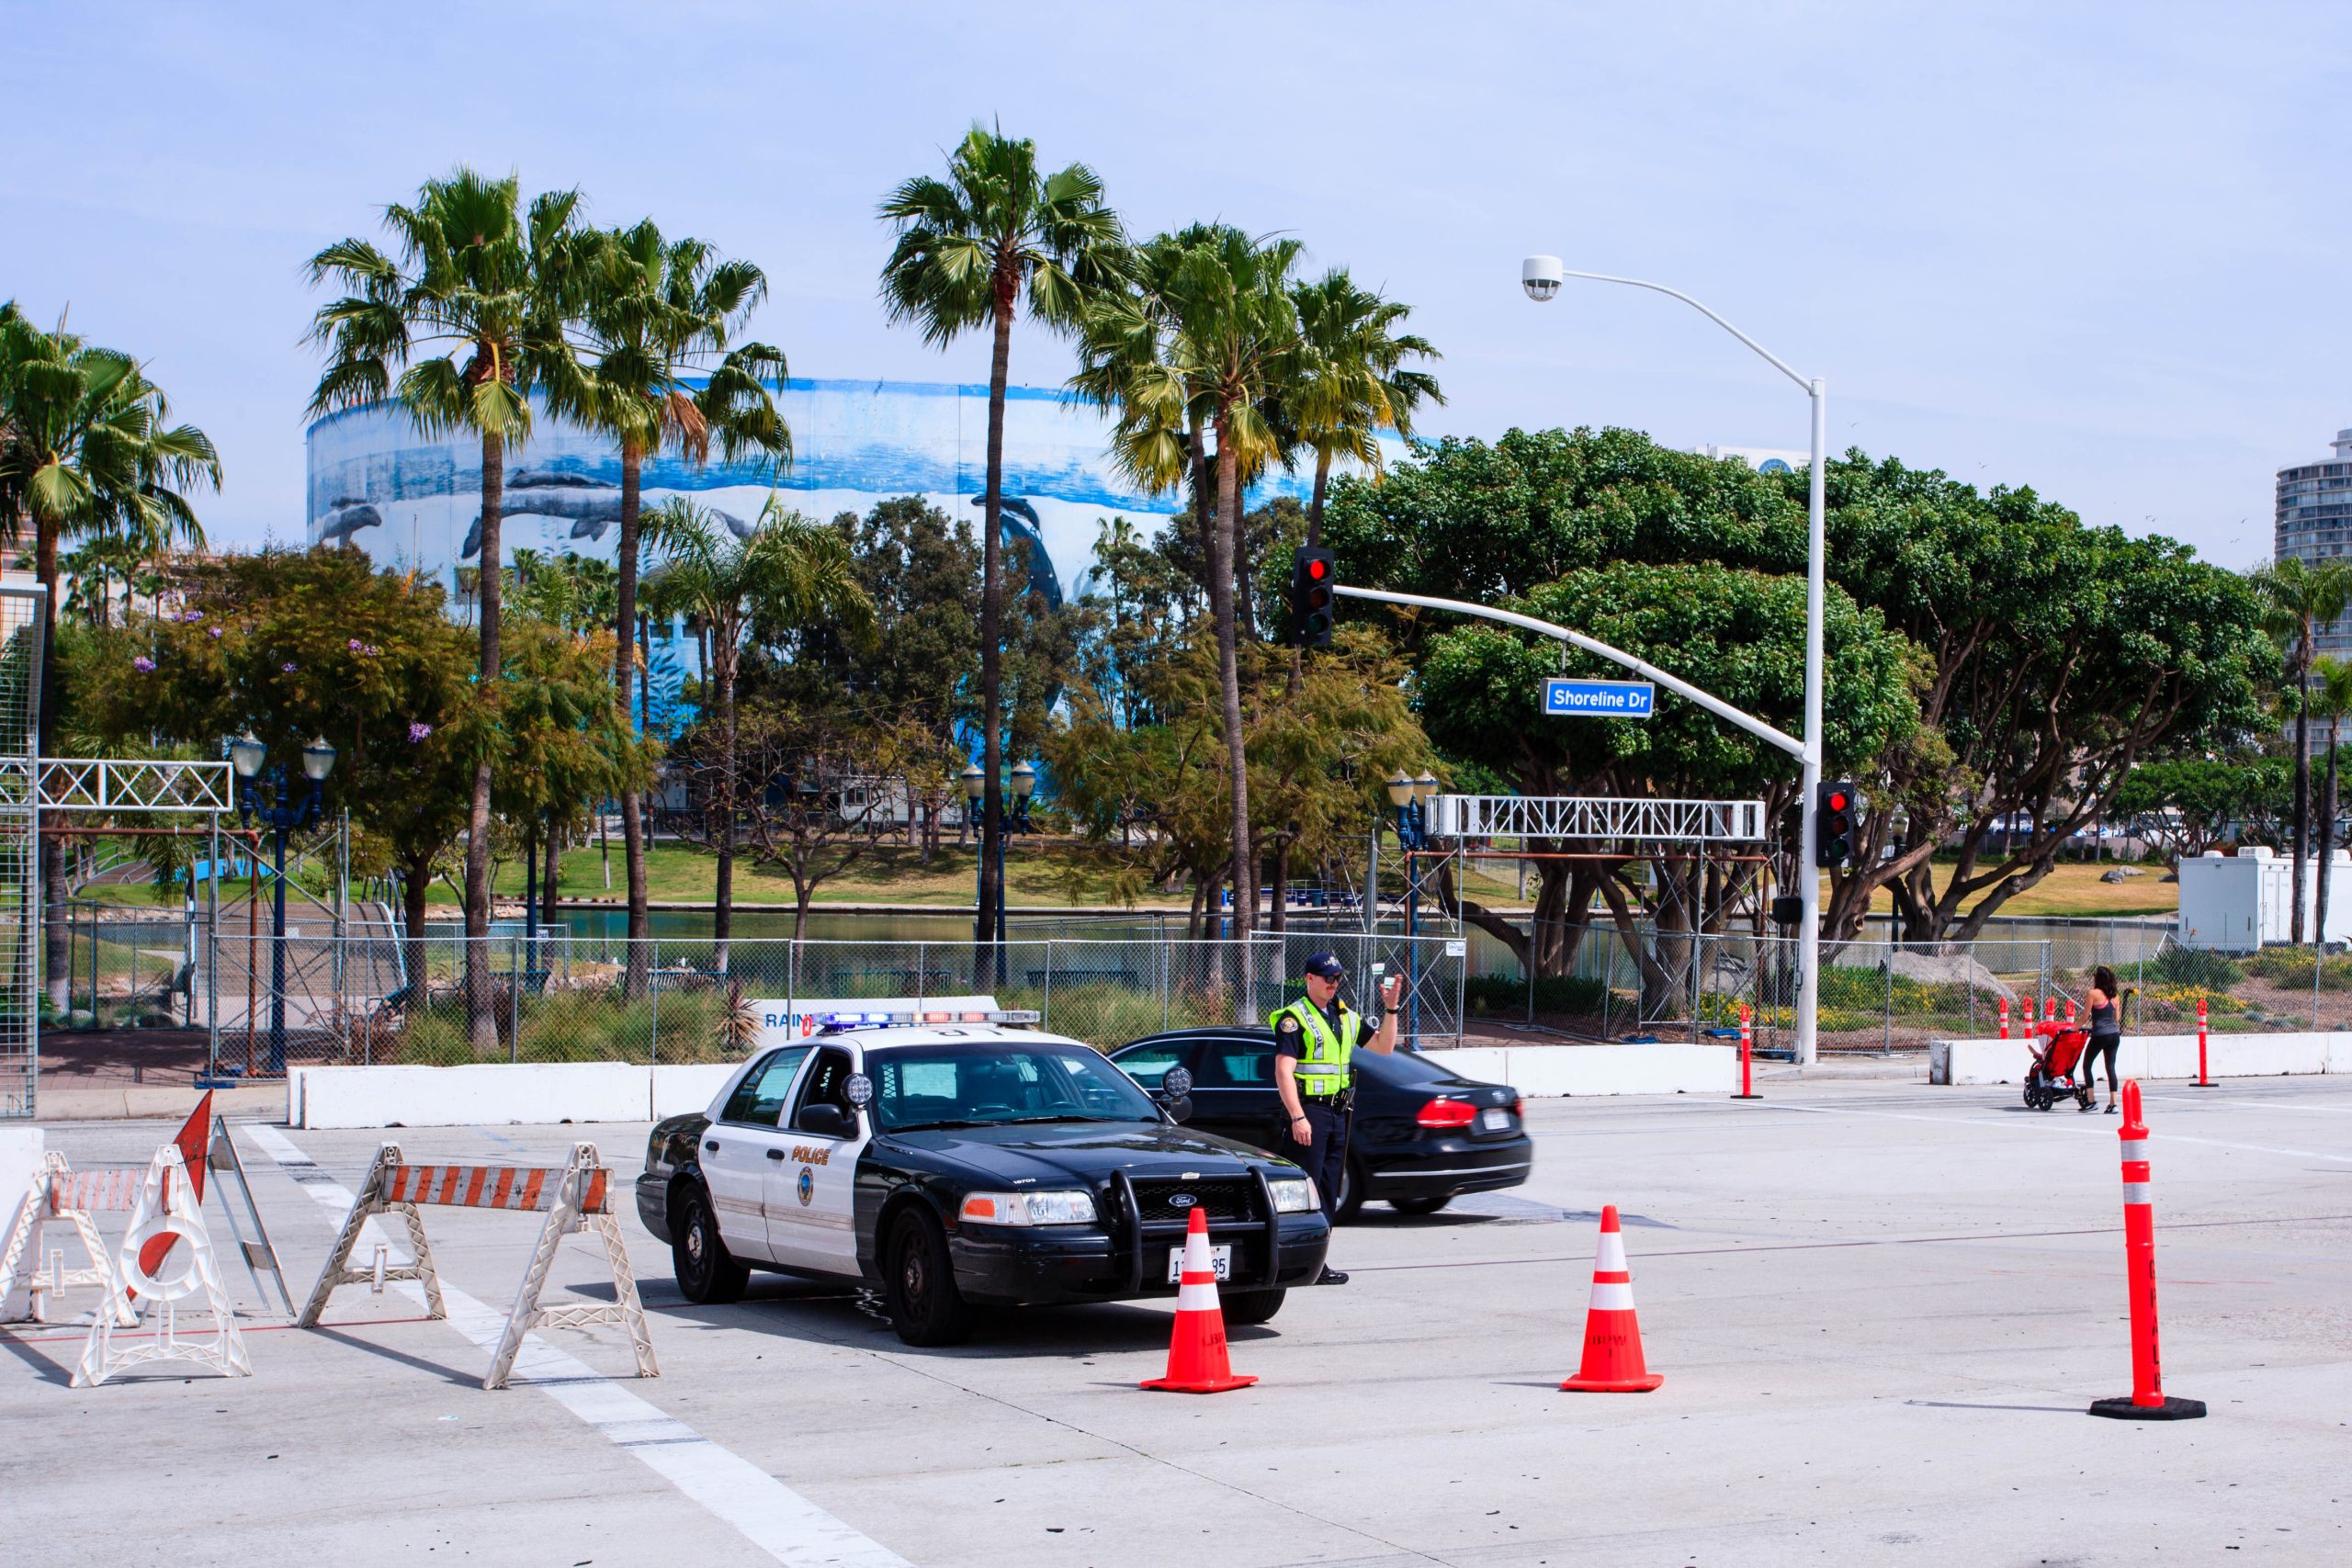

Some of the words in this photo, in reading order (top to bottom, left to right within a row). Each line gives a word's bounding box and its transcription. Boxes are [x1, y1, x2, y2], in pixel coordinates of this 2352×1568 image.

[1554, 689, 1625, 707] Shoreline
[1628, 692, 1647, 708] Dr
[765, 1013, 813, 1027] RAIN
[1302, 1010, 1323, 1048] POLICE
[791, 1145, 831, 1166] POLICE
[1176, 1196, 1191, 1204] Ford
